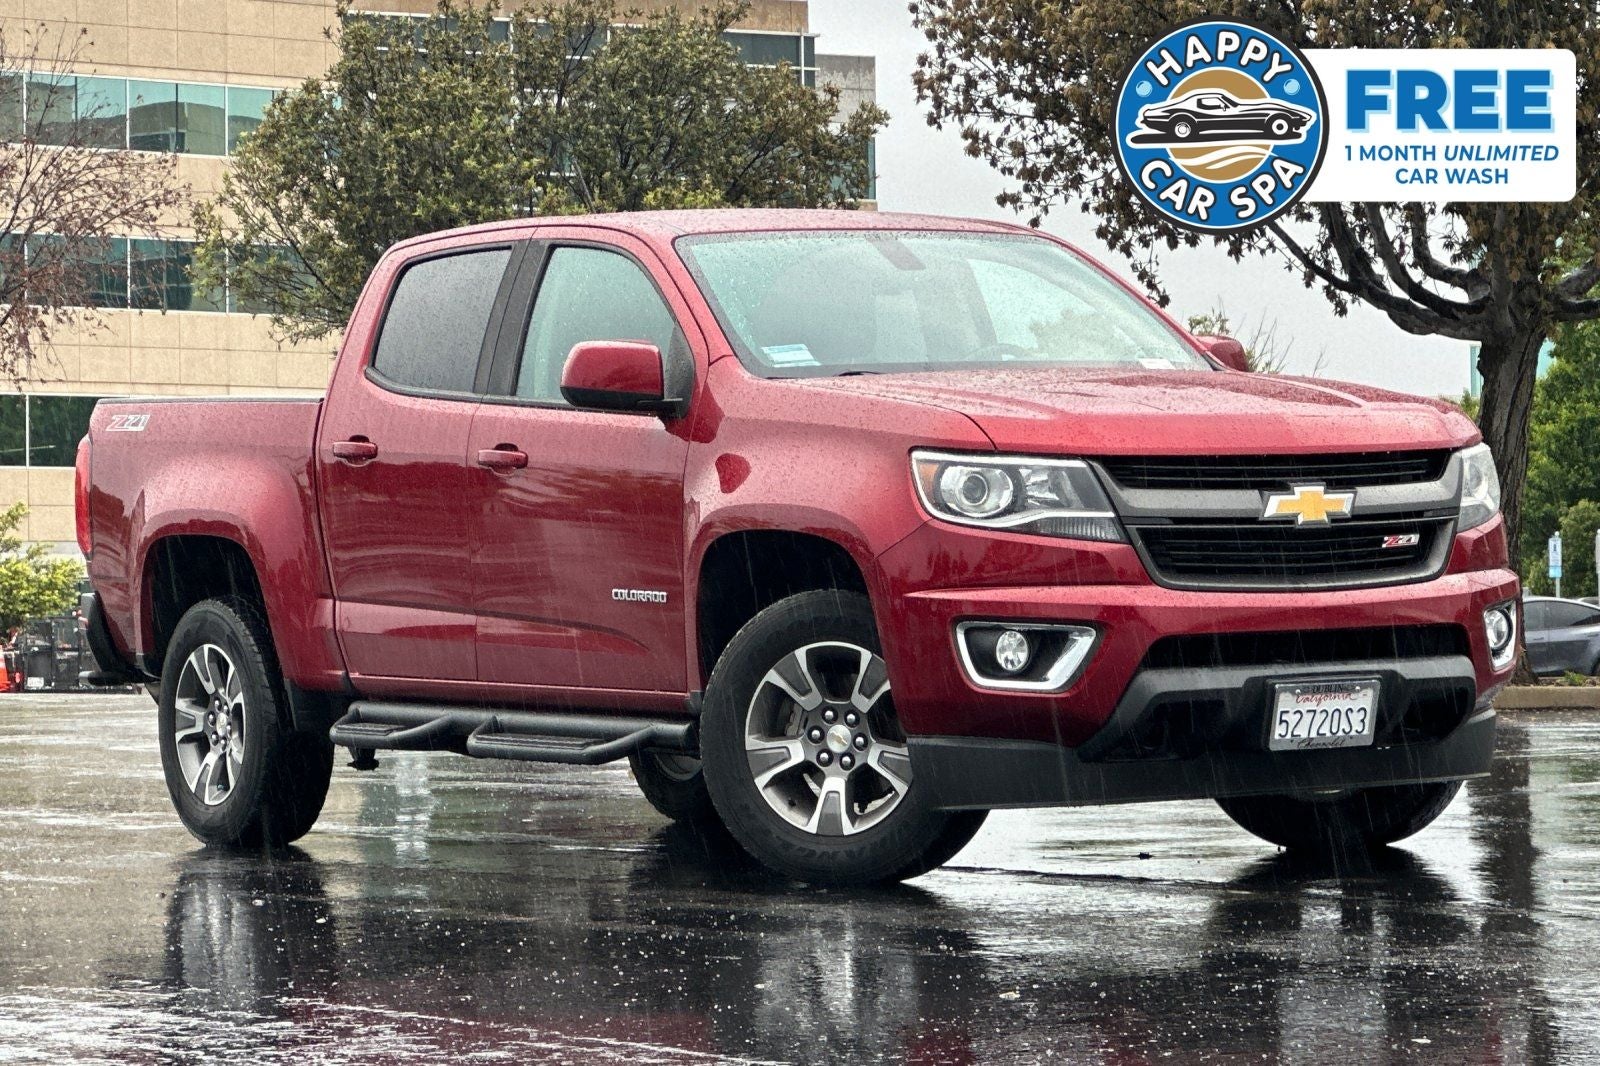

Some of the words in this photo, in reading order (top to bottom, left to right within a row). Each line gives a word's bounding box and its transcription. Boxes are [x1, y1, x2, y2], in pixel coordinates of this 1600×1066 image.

[105, 414, 151, 432] Z71
[1381, 533, 1420, 548] Z71
[612, 588, 667, 603] COLORADO
[1295, 692, 1358, 706] California
[1278, 707, 1367, 738] 52720S3
